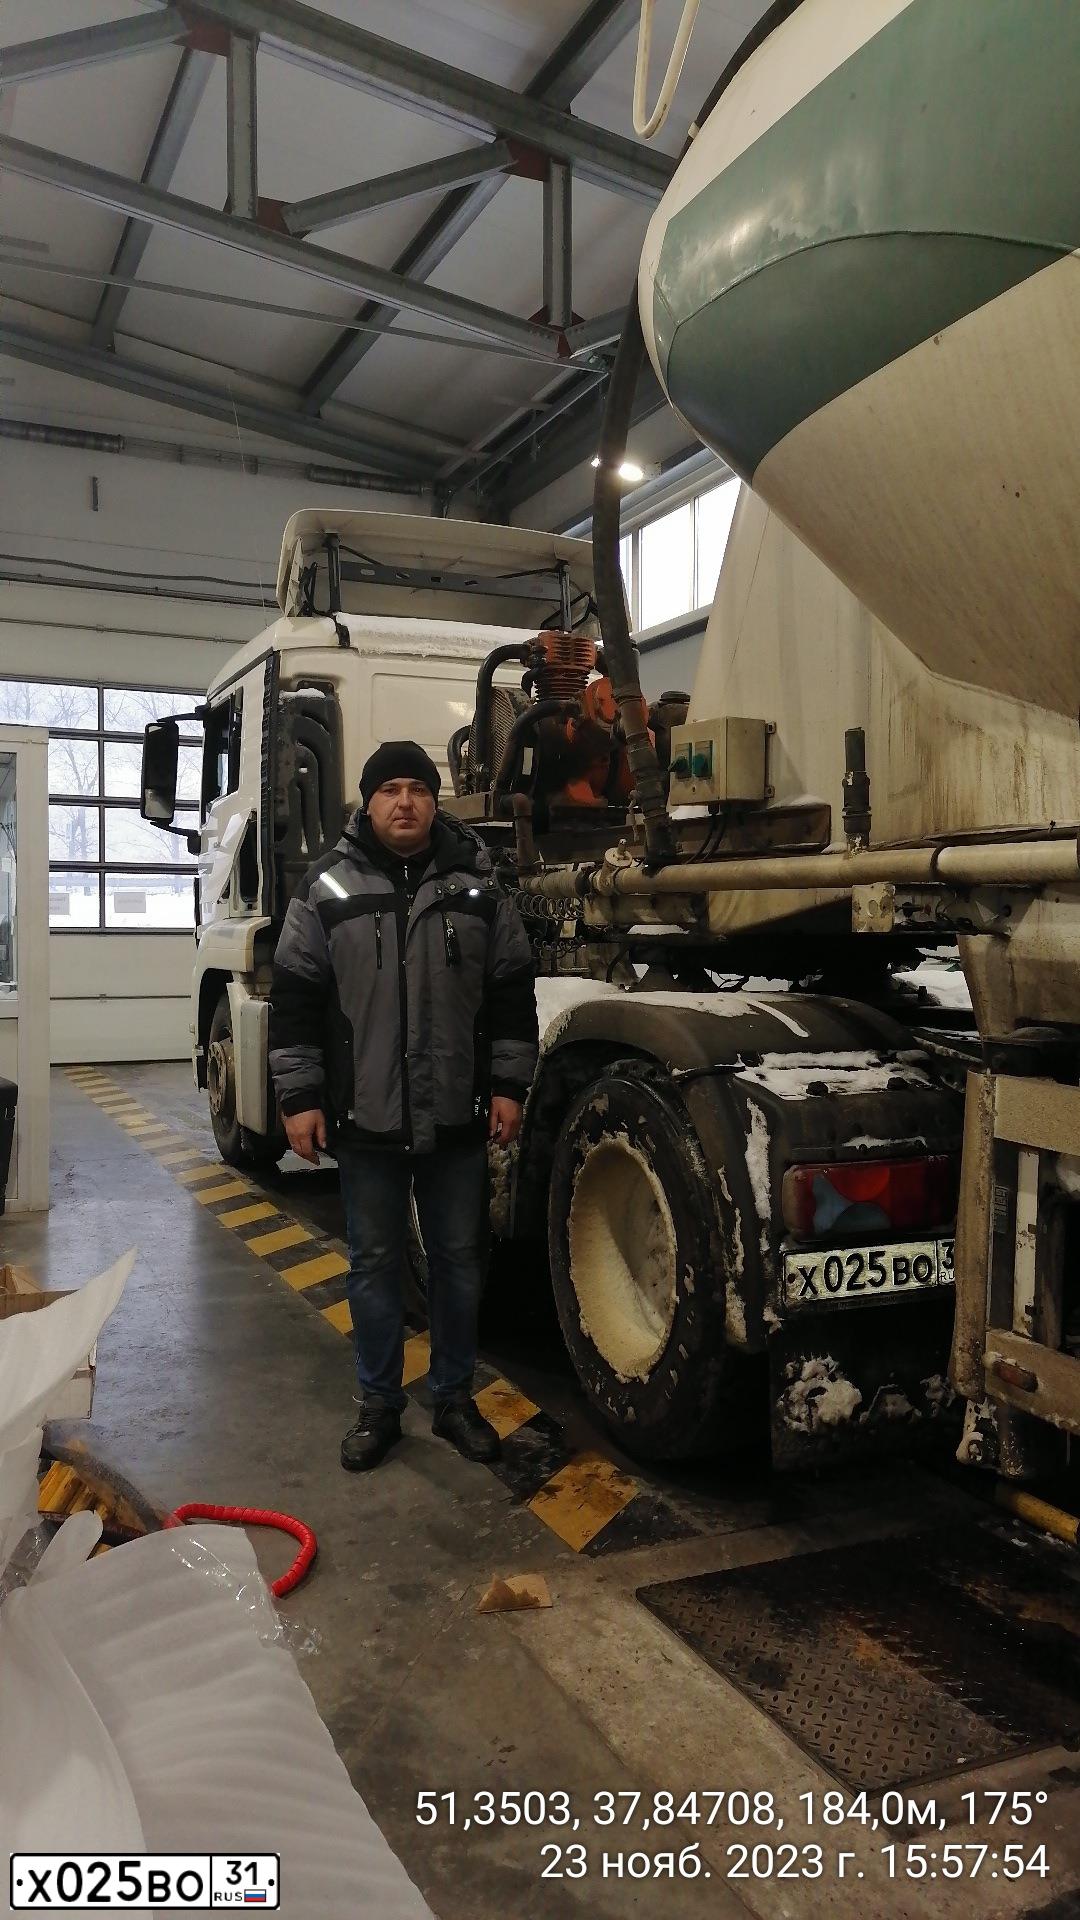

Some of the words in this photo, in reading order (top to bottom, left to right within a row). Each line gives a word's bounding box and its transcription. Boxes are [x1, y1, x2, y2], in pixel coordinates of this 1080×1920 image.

[941, 1241, 955, 1270] 3
[797, 1250, 933, 1297] Х025ВО
[940, 1270, 955, 1281] RU
